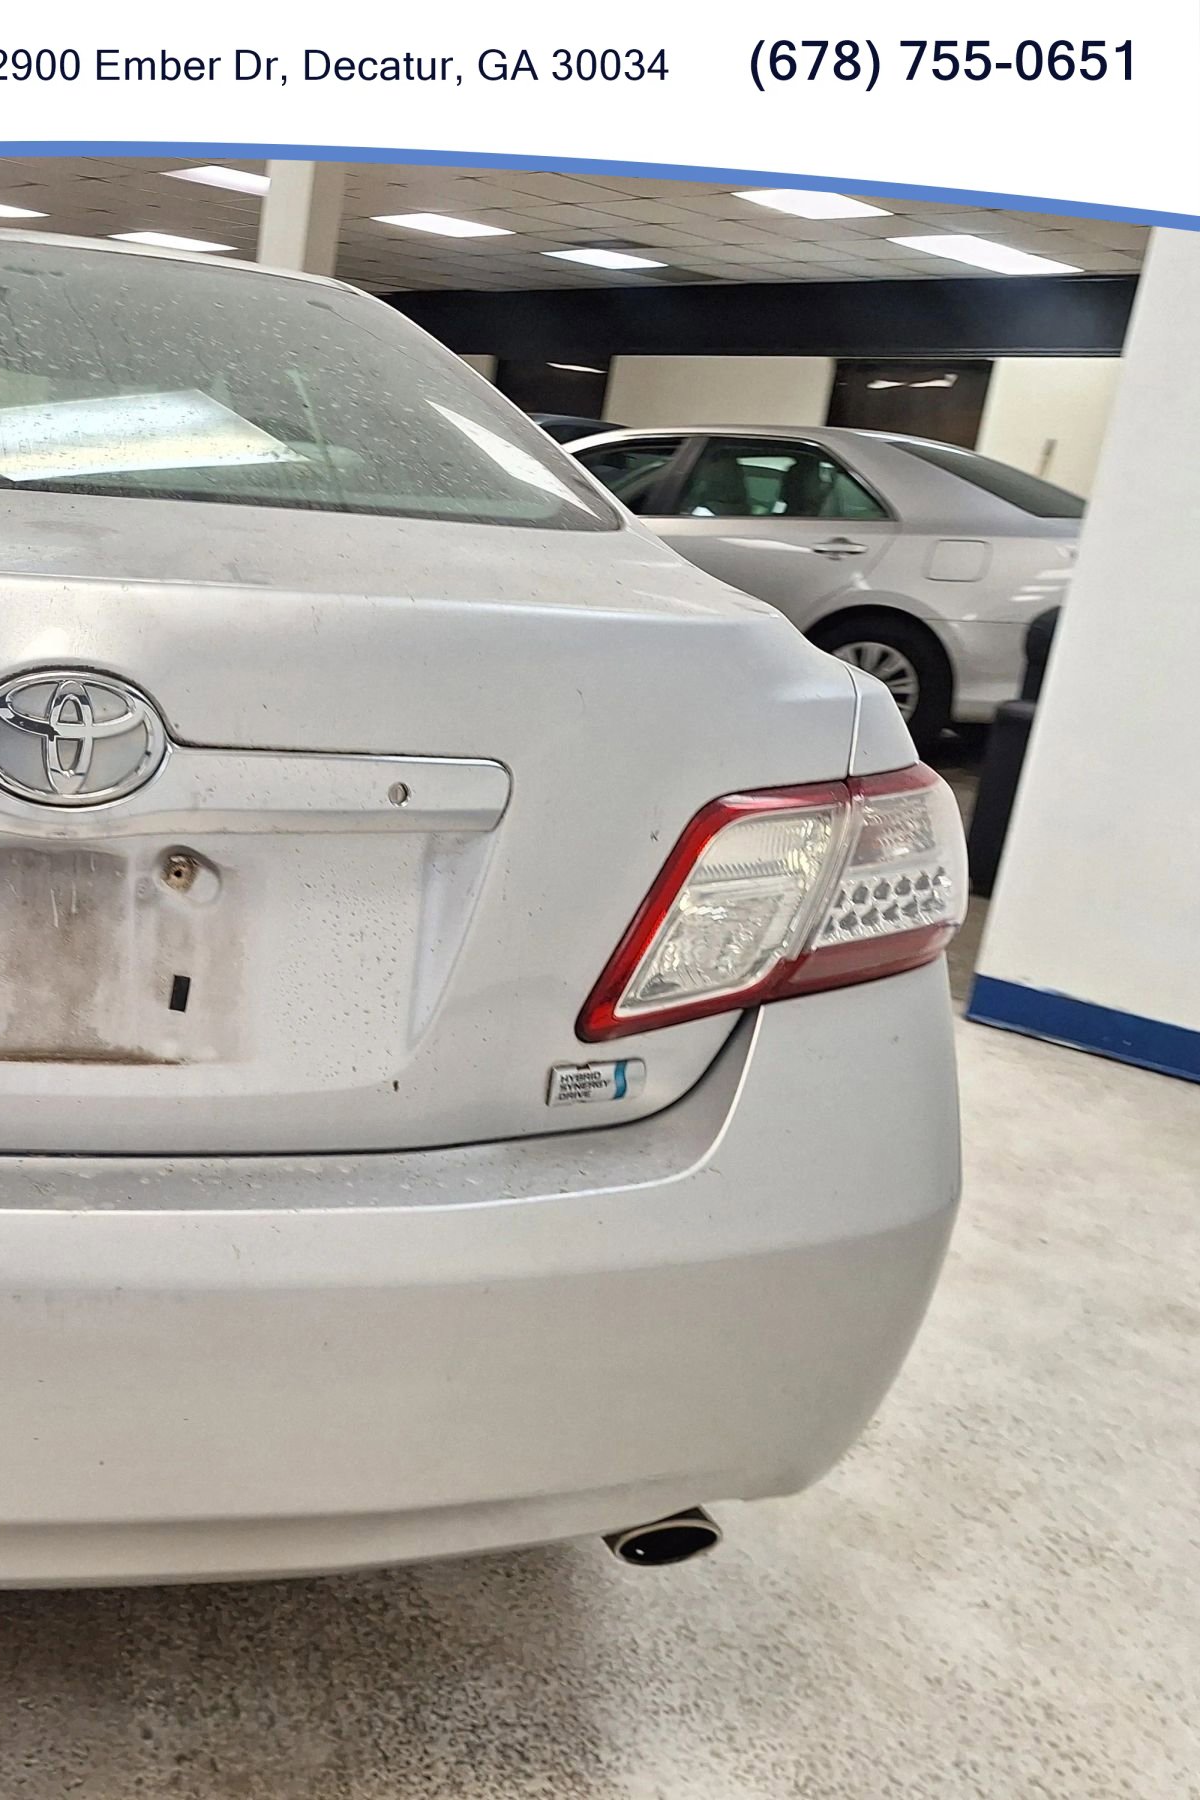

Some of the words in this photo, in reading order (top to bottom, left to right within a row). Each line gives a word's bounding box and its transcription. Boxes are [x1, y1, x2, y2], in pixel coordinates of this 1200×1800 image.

[559, 1072, 602, 1084] HYBRID
[558, 1079, 610, 1092] SYNERGY
[557, 1090, 592, 1101] DRIVE
